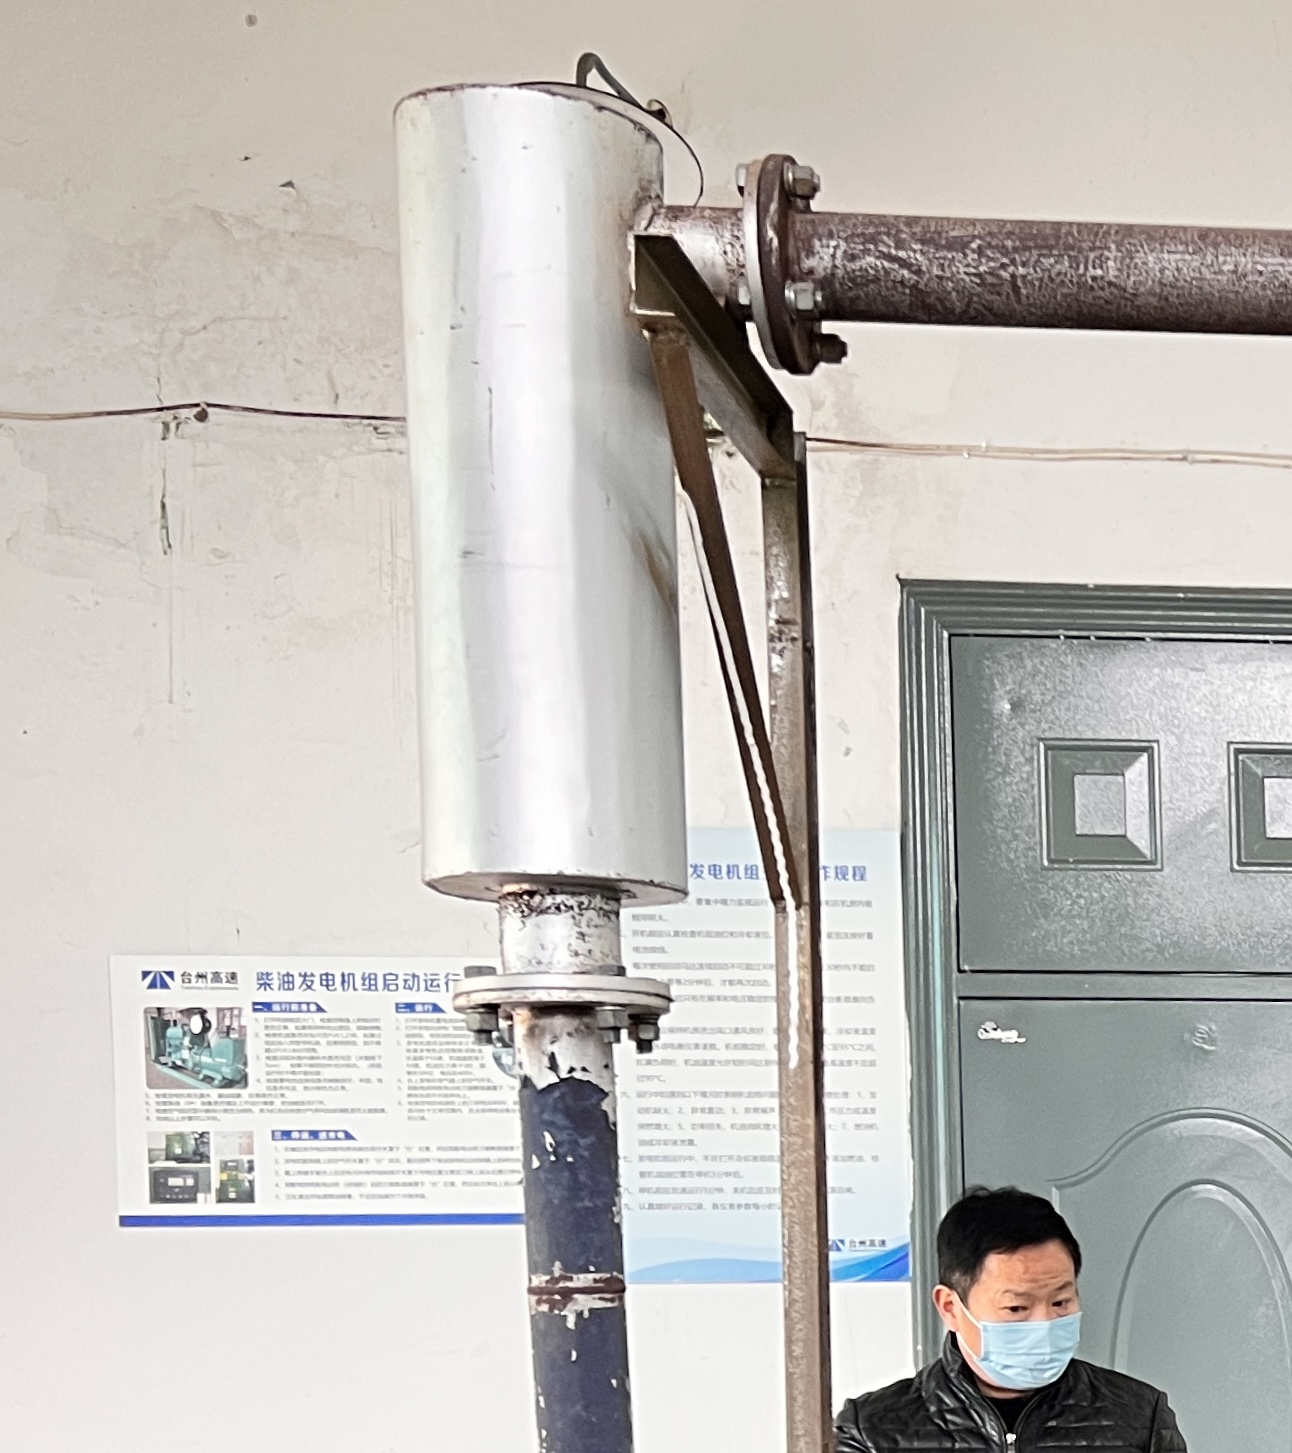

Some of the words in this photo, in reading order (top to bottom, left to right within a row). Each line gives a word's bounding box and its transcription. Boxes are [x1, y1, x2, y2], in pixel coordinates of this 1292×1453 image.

[689, 863, 760, 881] 发电机组
[180, 970, 239, 985] 台州高速
